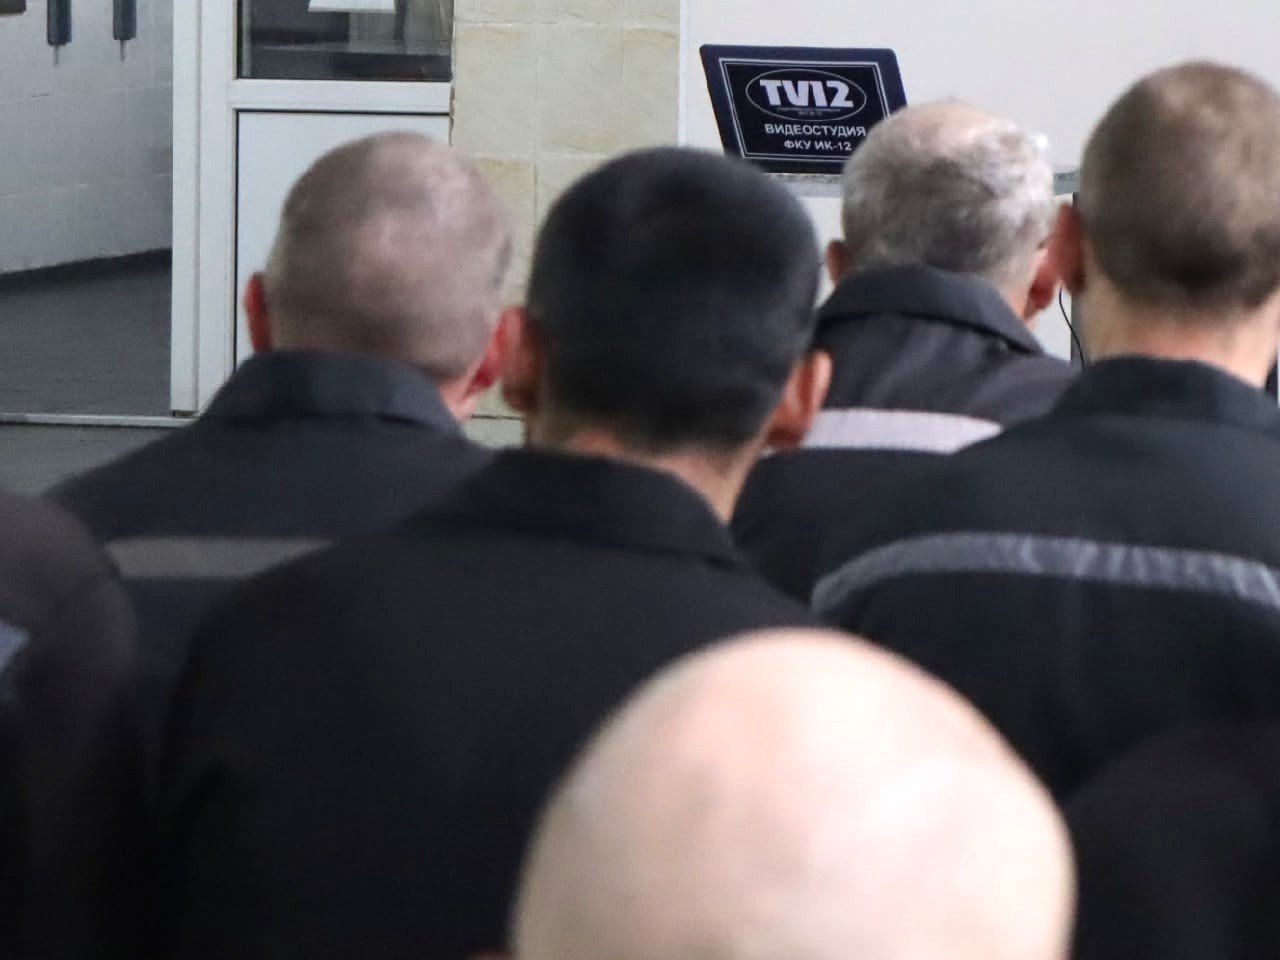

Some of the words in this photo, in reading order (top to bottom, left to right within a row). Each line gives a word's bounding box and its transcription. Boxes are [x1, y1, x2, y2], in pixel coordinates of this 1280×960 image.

[760, 79, 854, 107] TV12
[765, 123, 866, 137] ВИДЕОСТУДИЯ
[784, 140, 811, 150] ФКУ
[815, 141, 852, 151] ИК-12
